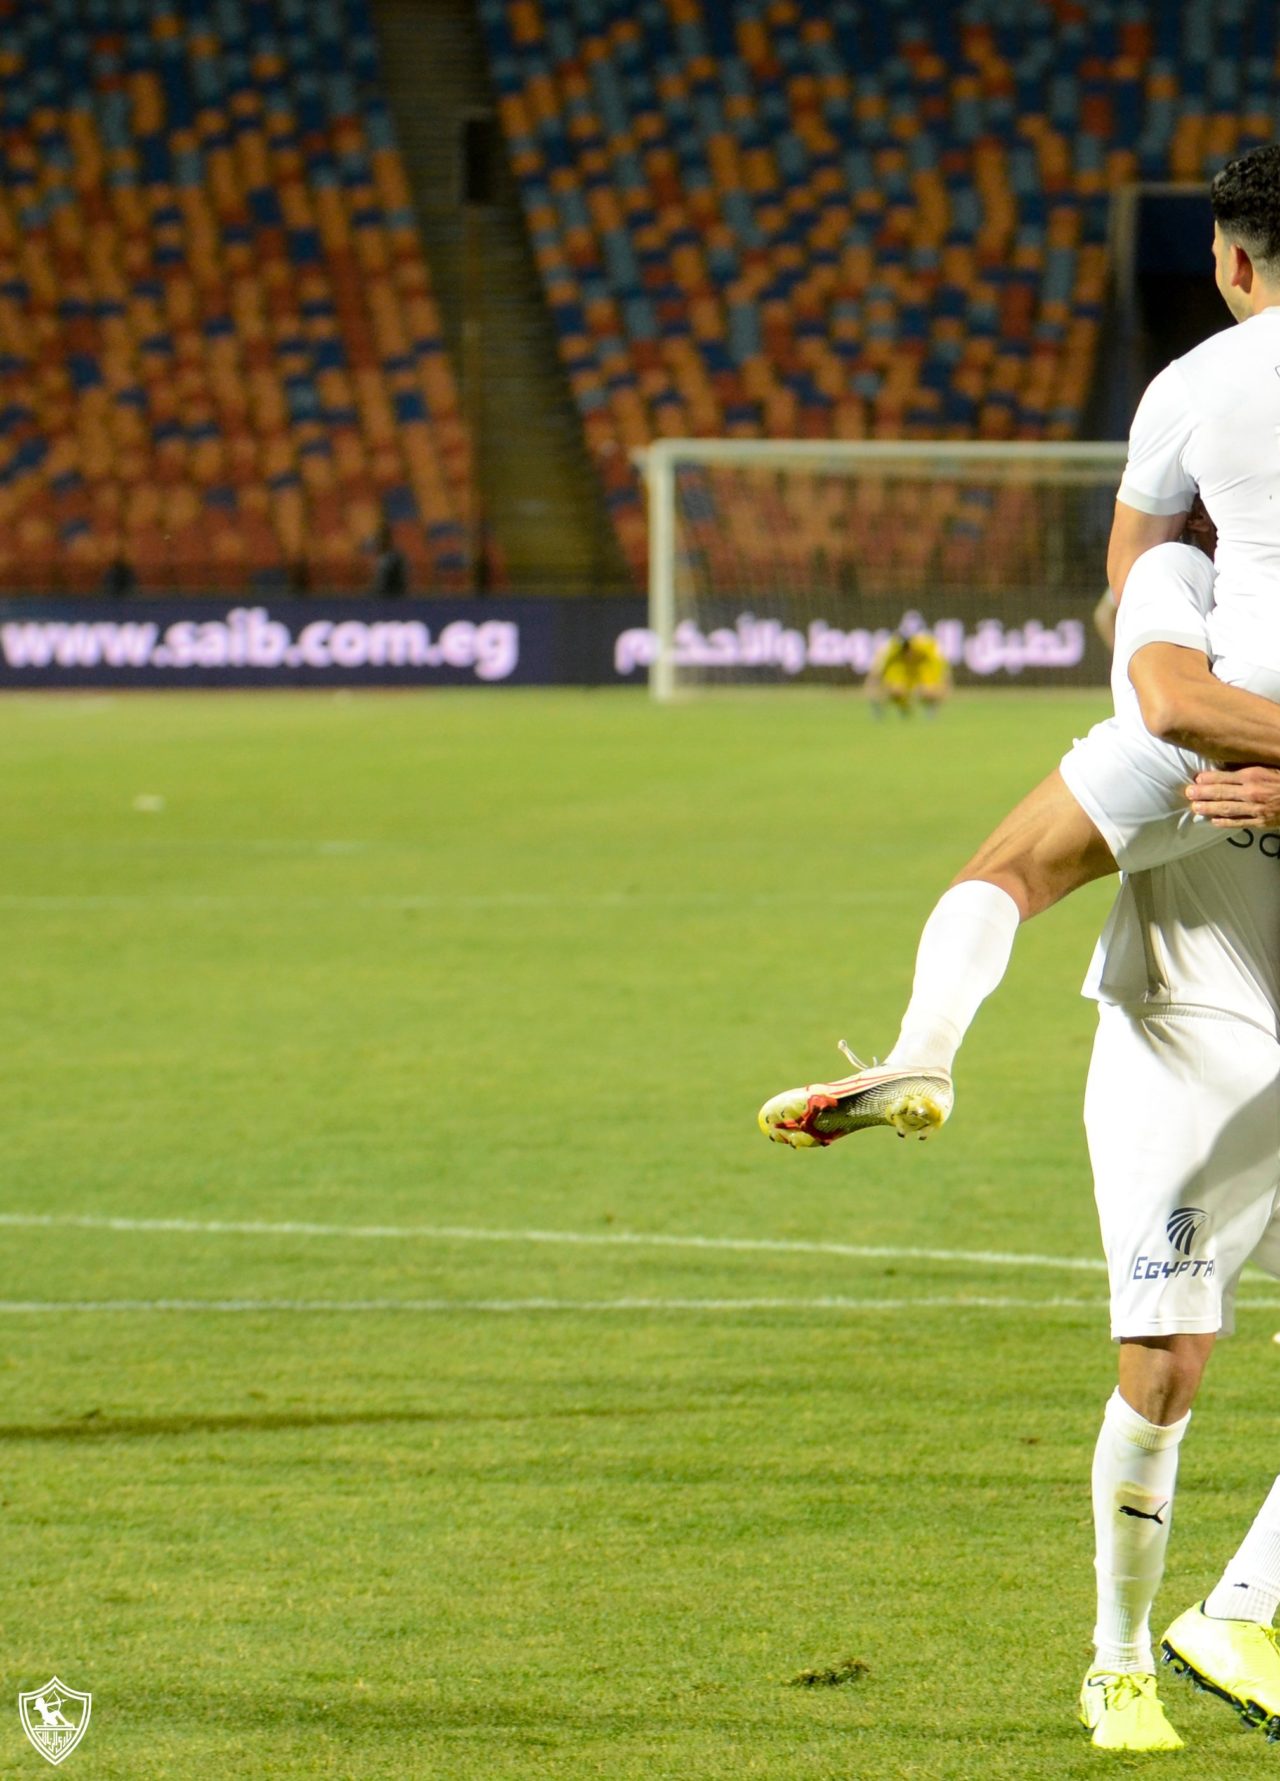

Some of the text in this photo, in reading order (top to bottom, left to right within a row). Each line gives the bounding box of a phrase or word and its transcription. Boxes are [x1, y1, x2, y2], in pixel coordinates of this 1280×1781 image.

[1, 606, 519, 681] www.saib.com.eg
[614, 610, 806, 675] والأحكم
[1132, 1256, 1215, 1280] EGYPTA
